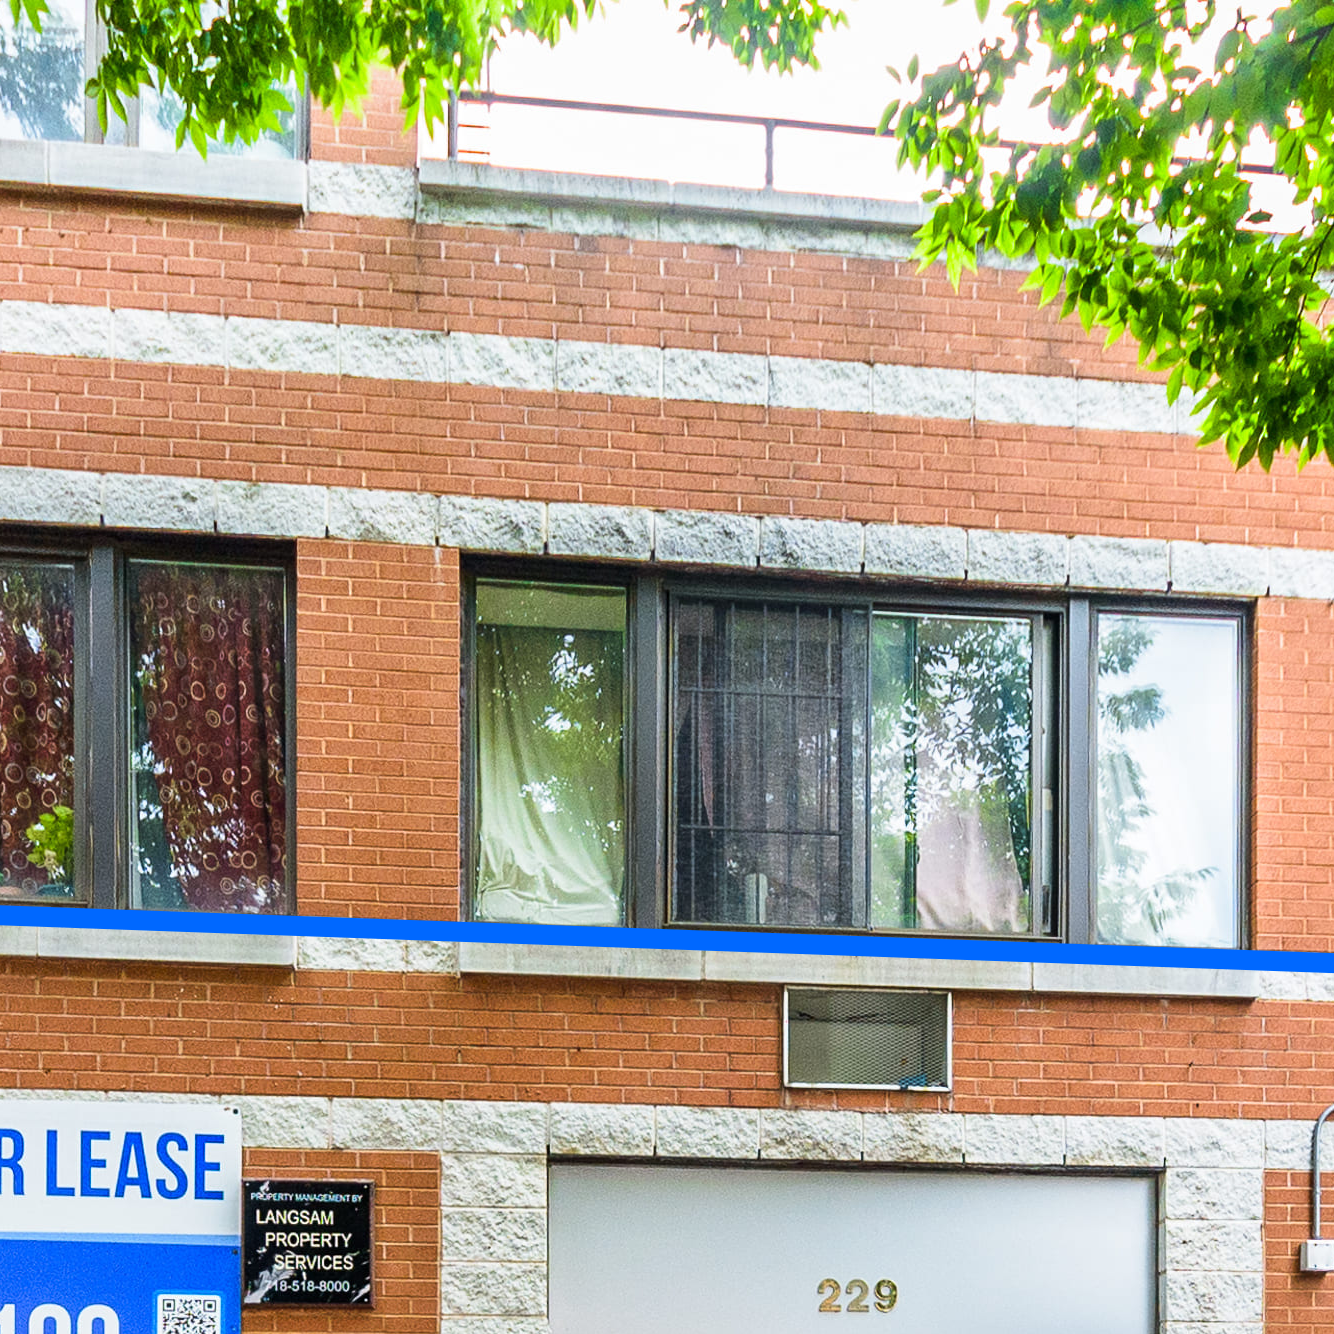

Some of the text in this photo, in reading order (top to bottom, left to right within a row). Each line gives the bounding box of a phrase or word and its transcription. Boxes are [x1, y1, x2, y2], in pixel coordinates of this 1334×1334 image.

[46, 1129, 225, 1201] LEASE
[250, 1192, 363, 1203] PROPERTY MANAGEMENT BY
[255, 1209, 334, 1225] LANGSAM
[265, 1232, 353, 1248] PROPERTY
[274, 1254, 354, 1270] SERVICES
[817, 1278, 898, 1314] 229
